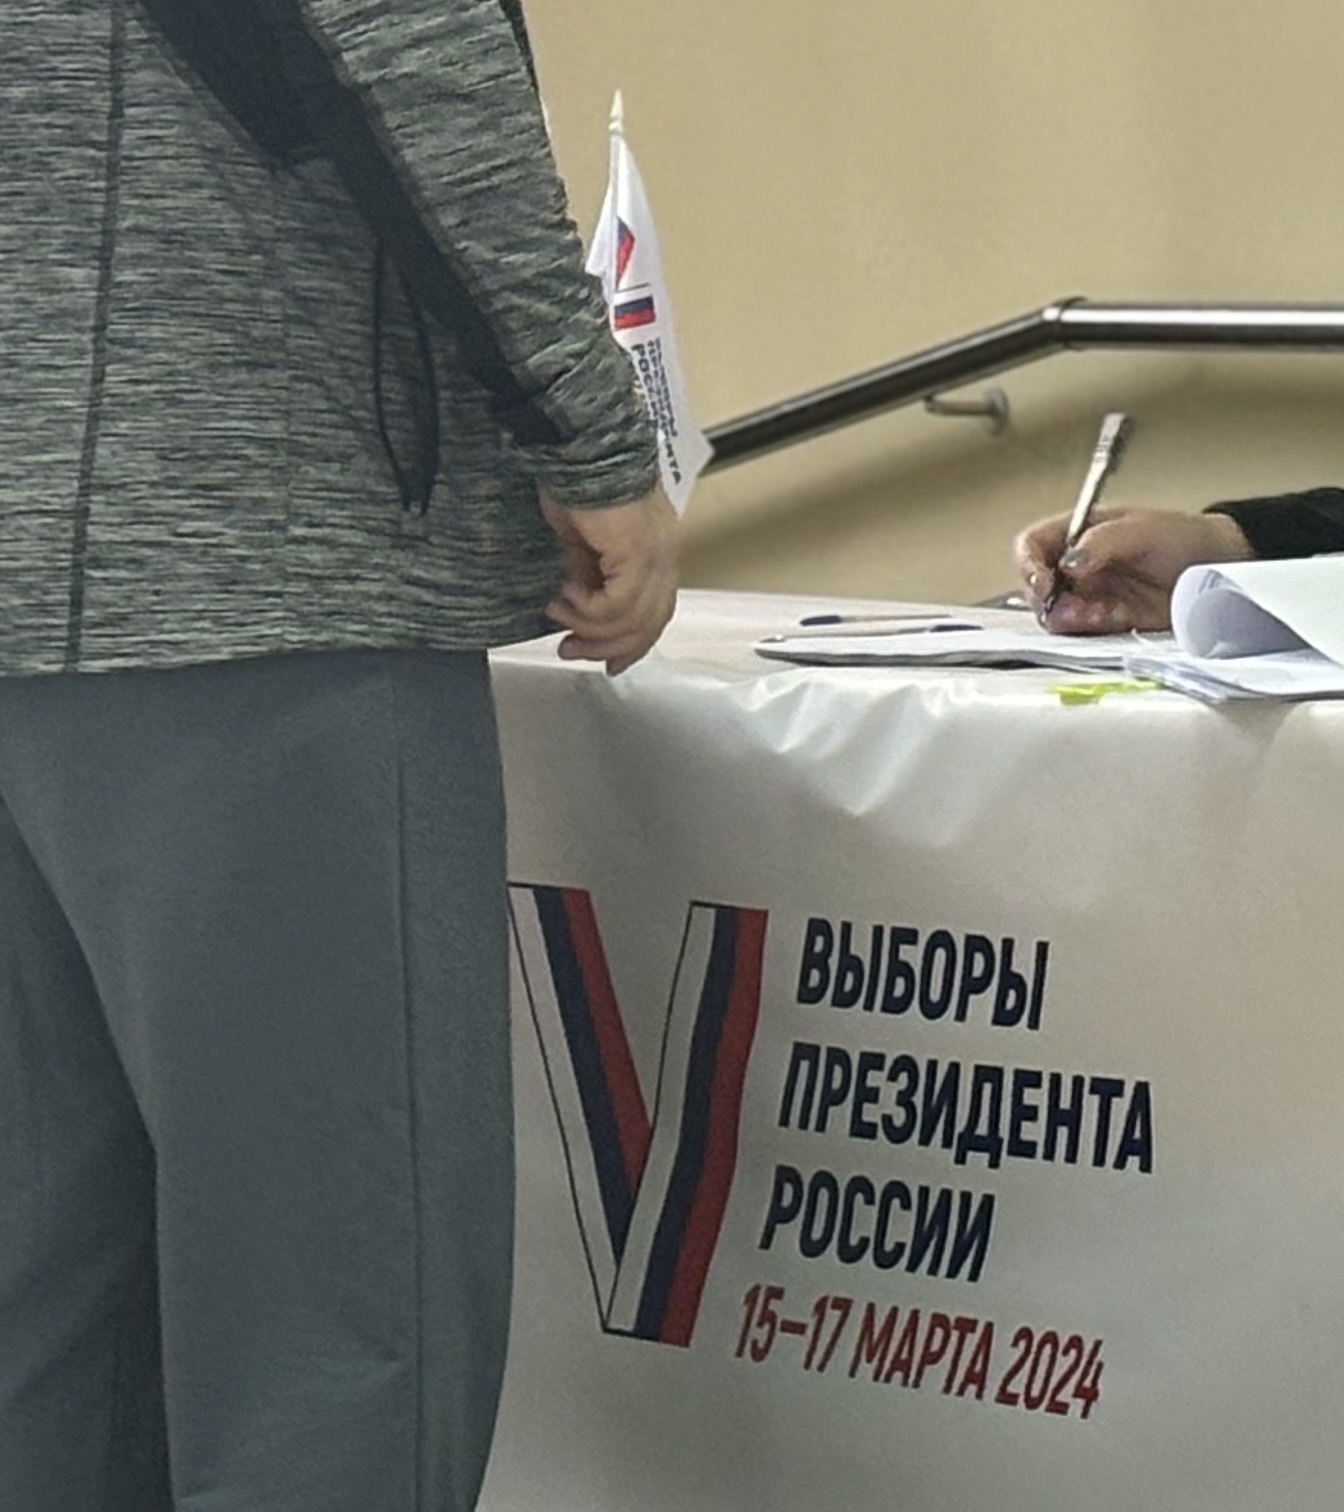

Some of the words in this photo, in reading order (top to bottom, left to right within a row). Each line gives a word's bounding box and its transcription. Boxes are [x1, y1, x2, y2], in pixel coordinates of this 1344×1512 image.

[797, 918, 1050, 1031] ВЫБОРЫ
[778, 1041, 1154, 1174] ПРЕЗИДЕНТА
[759, 1165, 996, 1283] РОССИИ
[849, 1302, 997, 1401] МАРТА
[995, 1326, 1104, 1420] 2024
